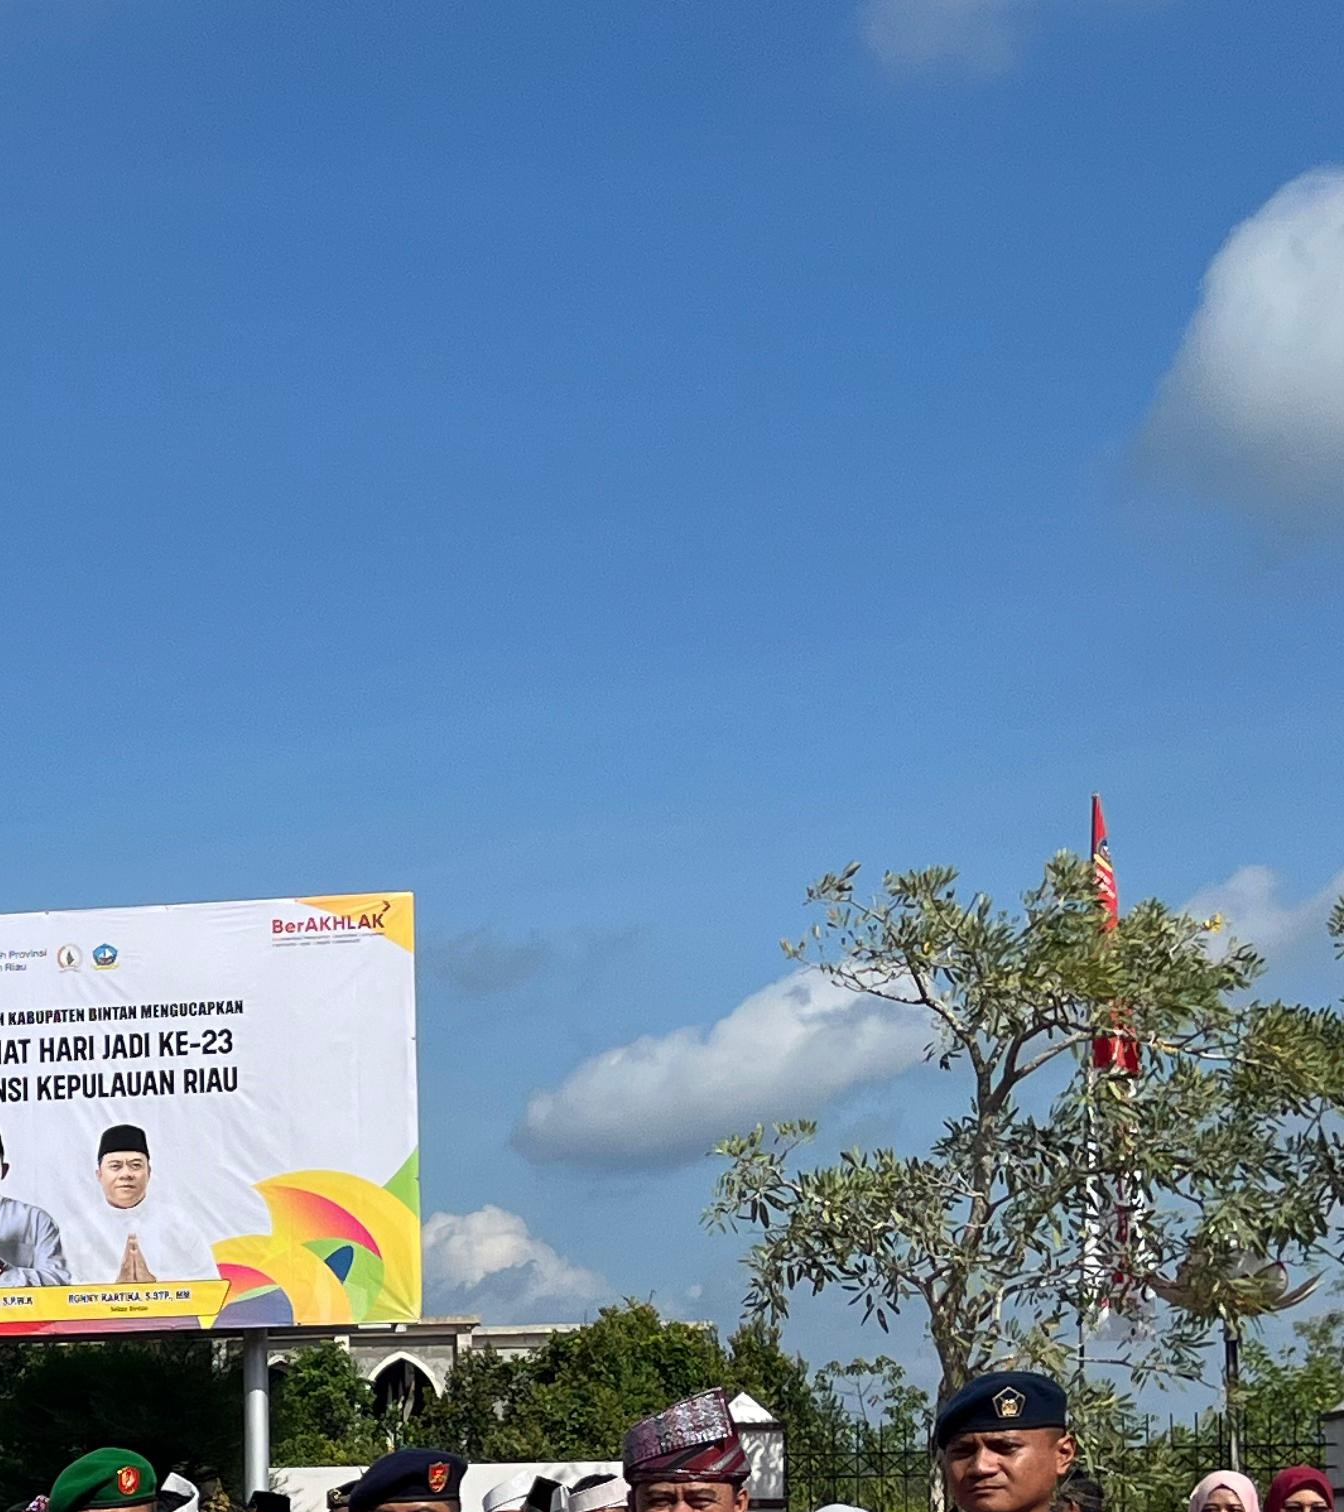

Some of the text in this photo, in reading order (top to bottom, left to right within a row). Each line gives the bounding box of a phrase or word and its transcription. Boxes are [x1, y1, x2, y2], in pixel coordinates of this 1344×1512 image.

[272, 913, 385, 933] BerAKHLAK
[9, 949, 48, 960] Provinsi
[8, 1008, 85, 1026] KABUPATEN
[88, 1005, 137, 1022] BINTAN
[140, 1000, 244, 1019] MENGUCAPKAN
[39, 1035, 95, 1063] HARI
[102, 1032, 151, 1060] JADI
[159, 1028, 233, 1057] KE-23
[37, 1070, 175, 1101] KEPULAUAN
[183, 1066, 238, 1094] RIAU
